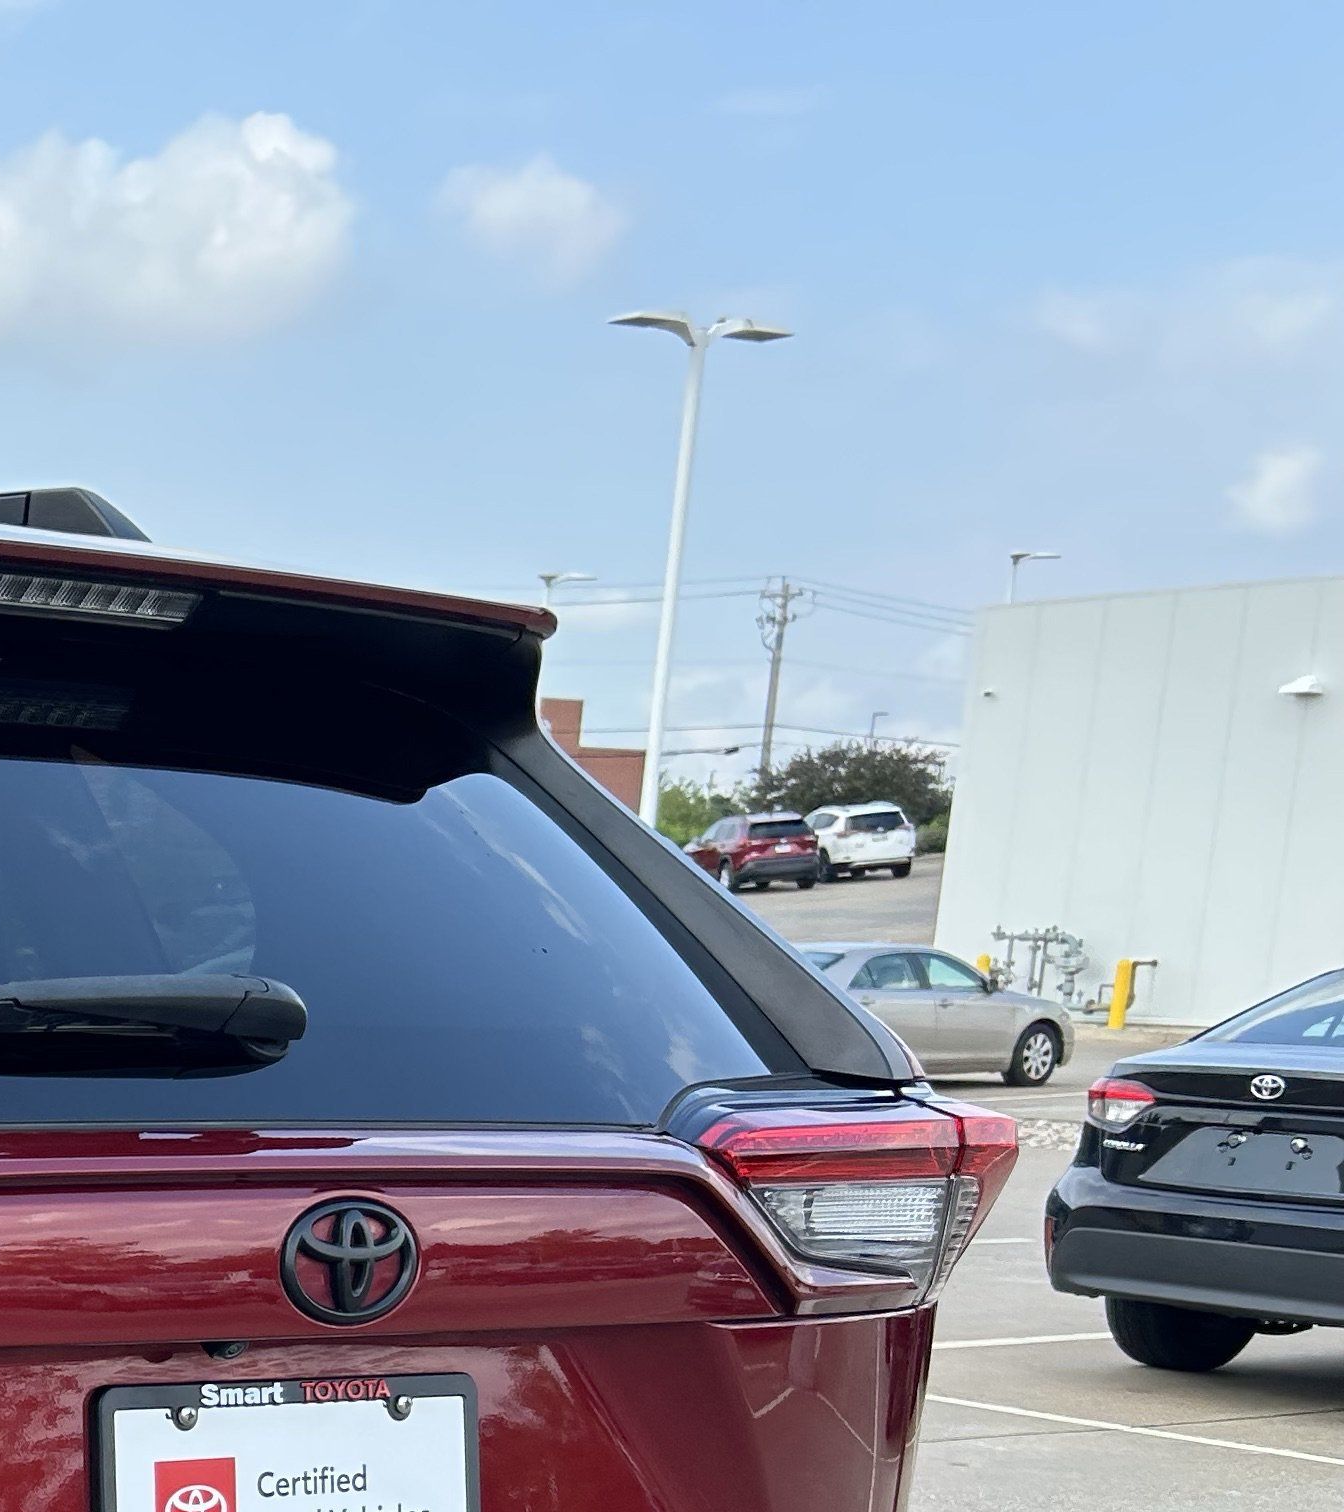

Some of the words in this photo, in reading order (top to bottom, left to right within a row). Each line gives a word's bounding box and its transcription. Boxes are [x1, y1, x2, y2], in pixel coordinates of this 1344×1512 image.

[200, 1383, 284, 1407] Smart
[301, 1379, 391, 1401] TOYOTA
[257, 1464, 367, 1498] Certified
